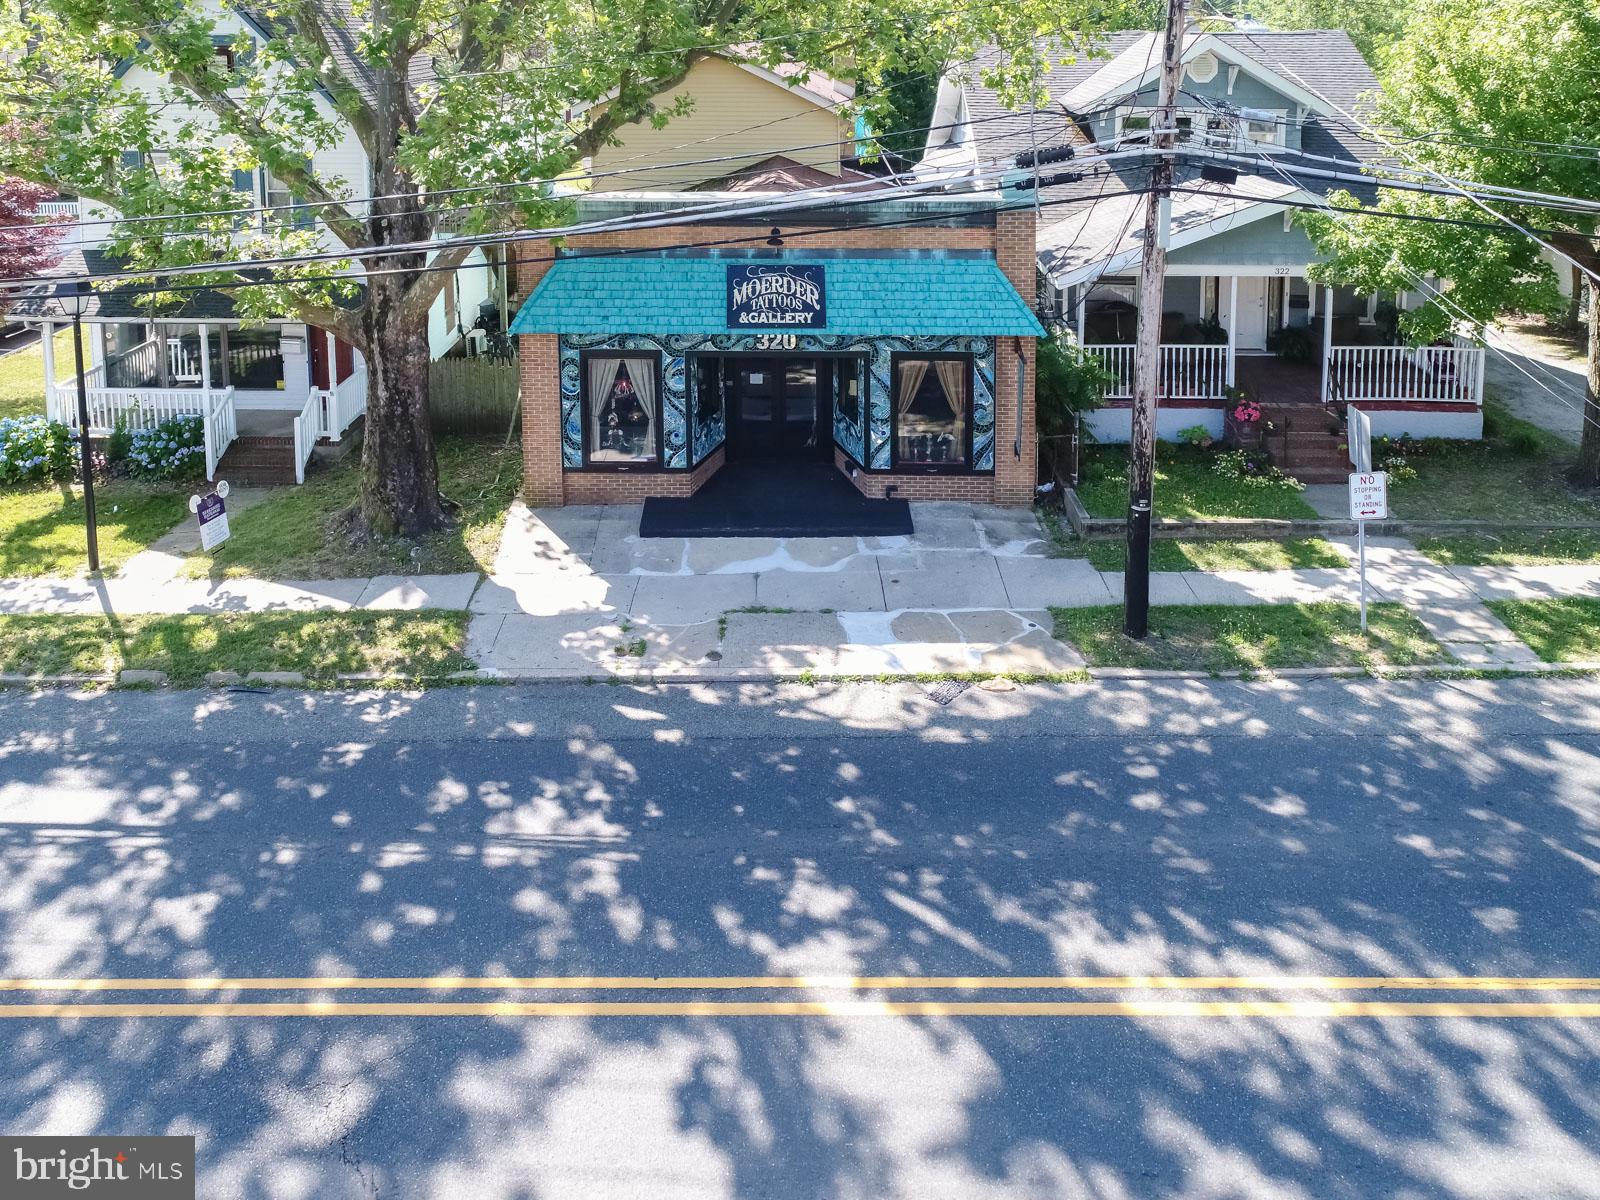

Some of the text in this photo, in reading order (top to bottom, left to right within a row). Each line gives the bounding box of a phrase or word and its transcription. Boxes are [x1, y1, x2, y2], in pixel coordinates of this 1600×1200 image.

[1275, 267, 1290, 275] 322
[732, 274, 820, 311] MOERDER
[750, 294, 803, 311] TATTOOS
[739, 311, 814, 324] &GALLERY
[756, 334, 797, 350] 320
[1360, 476, 1375, 485] NO
